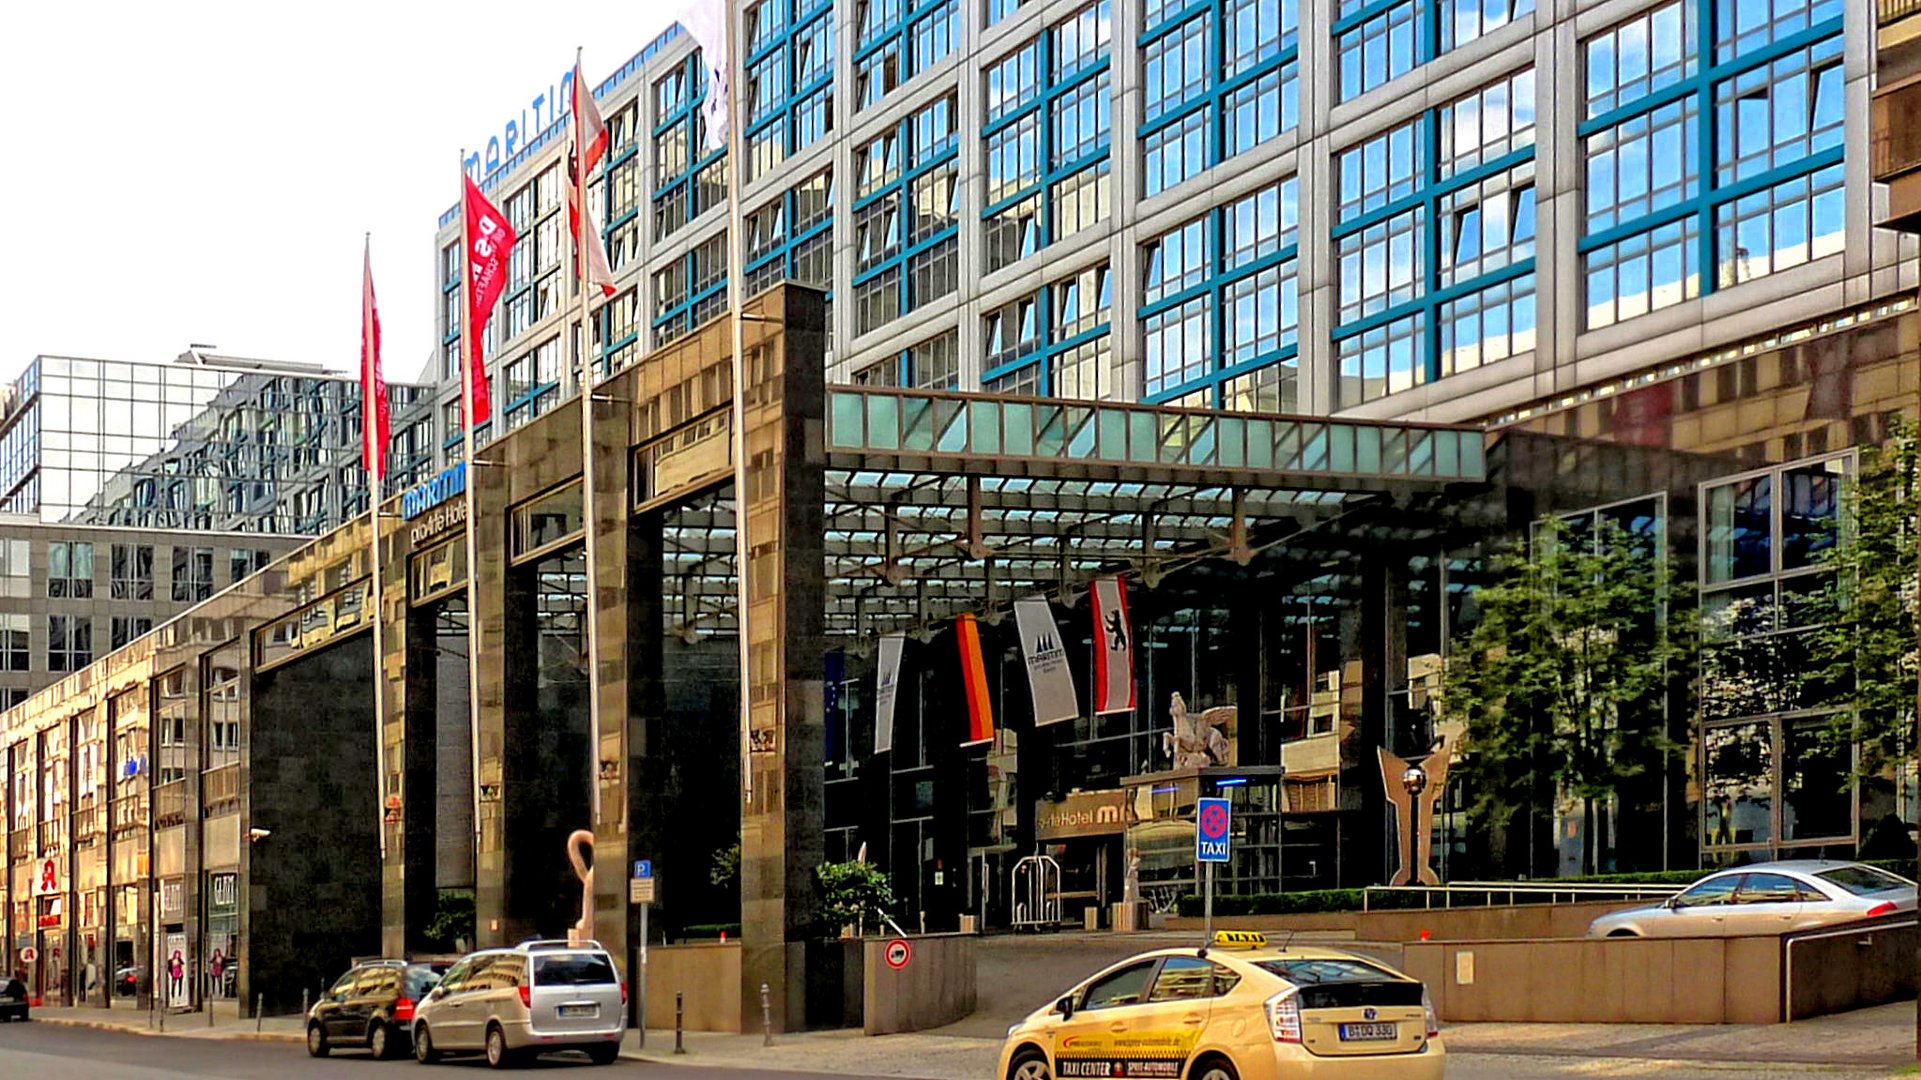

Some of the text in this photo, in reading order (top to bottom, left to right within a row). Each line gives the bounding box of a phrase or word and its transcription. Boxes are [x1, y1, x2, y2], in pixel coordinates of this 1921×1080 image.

[445, 499, 468, 527] Hote
[1201, 841, 1226, 855] TAXI
[41, 859, 57, 891] A
[637, 863, 646, 876] P
[1063, 1061, 1111, 1076] TAXI CENTER
